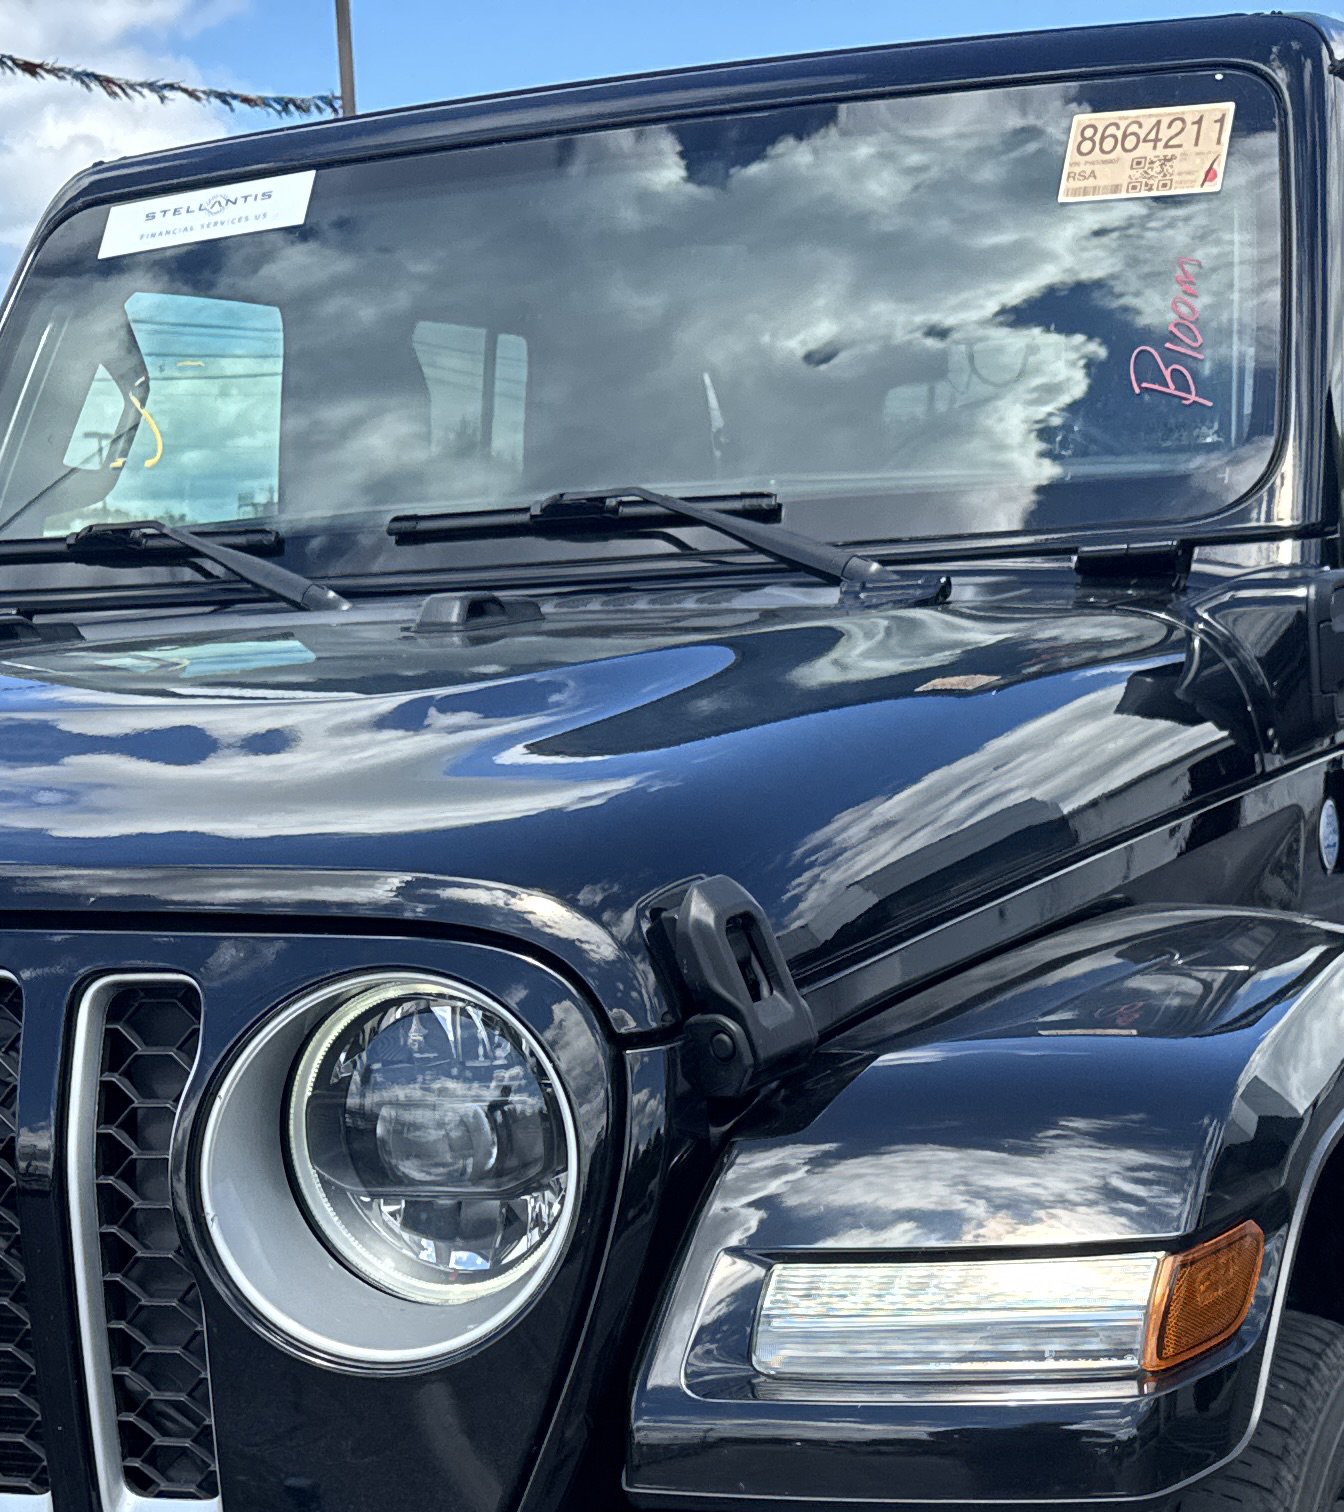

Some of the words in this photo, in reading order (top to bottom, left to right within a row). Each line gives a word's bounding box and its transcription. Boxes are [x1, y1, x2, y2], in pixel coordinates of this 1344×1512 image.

[1076, 113, 1226, 157] 8664211
[1066, 170, 1097, 183] RSA
[144, 190, 274, 221] STELLANTIS
[139, 225, 195, 240] FINANCIAL
[200, 216, 250, 231] SERVICES
